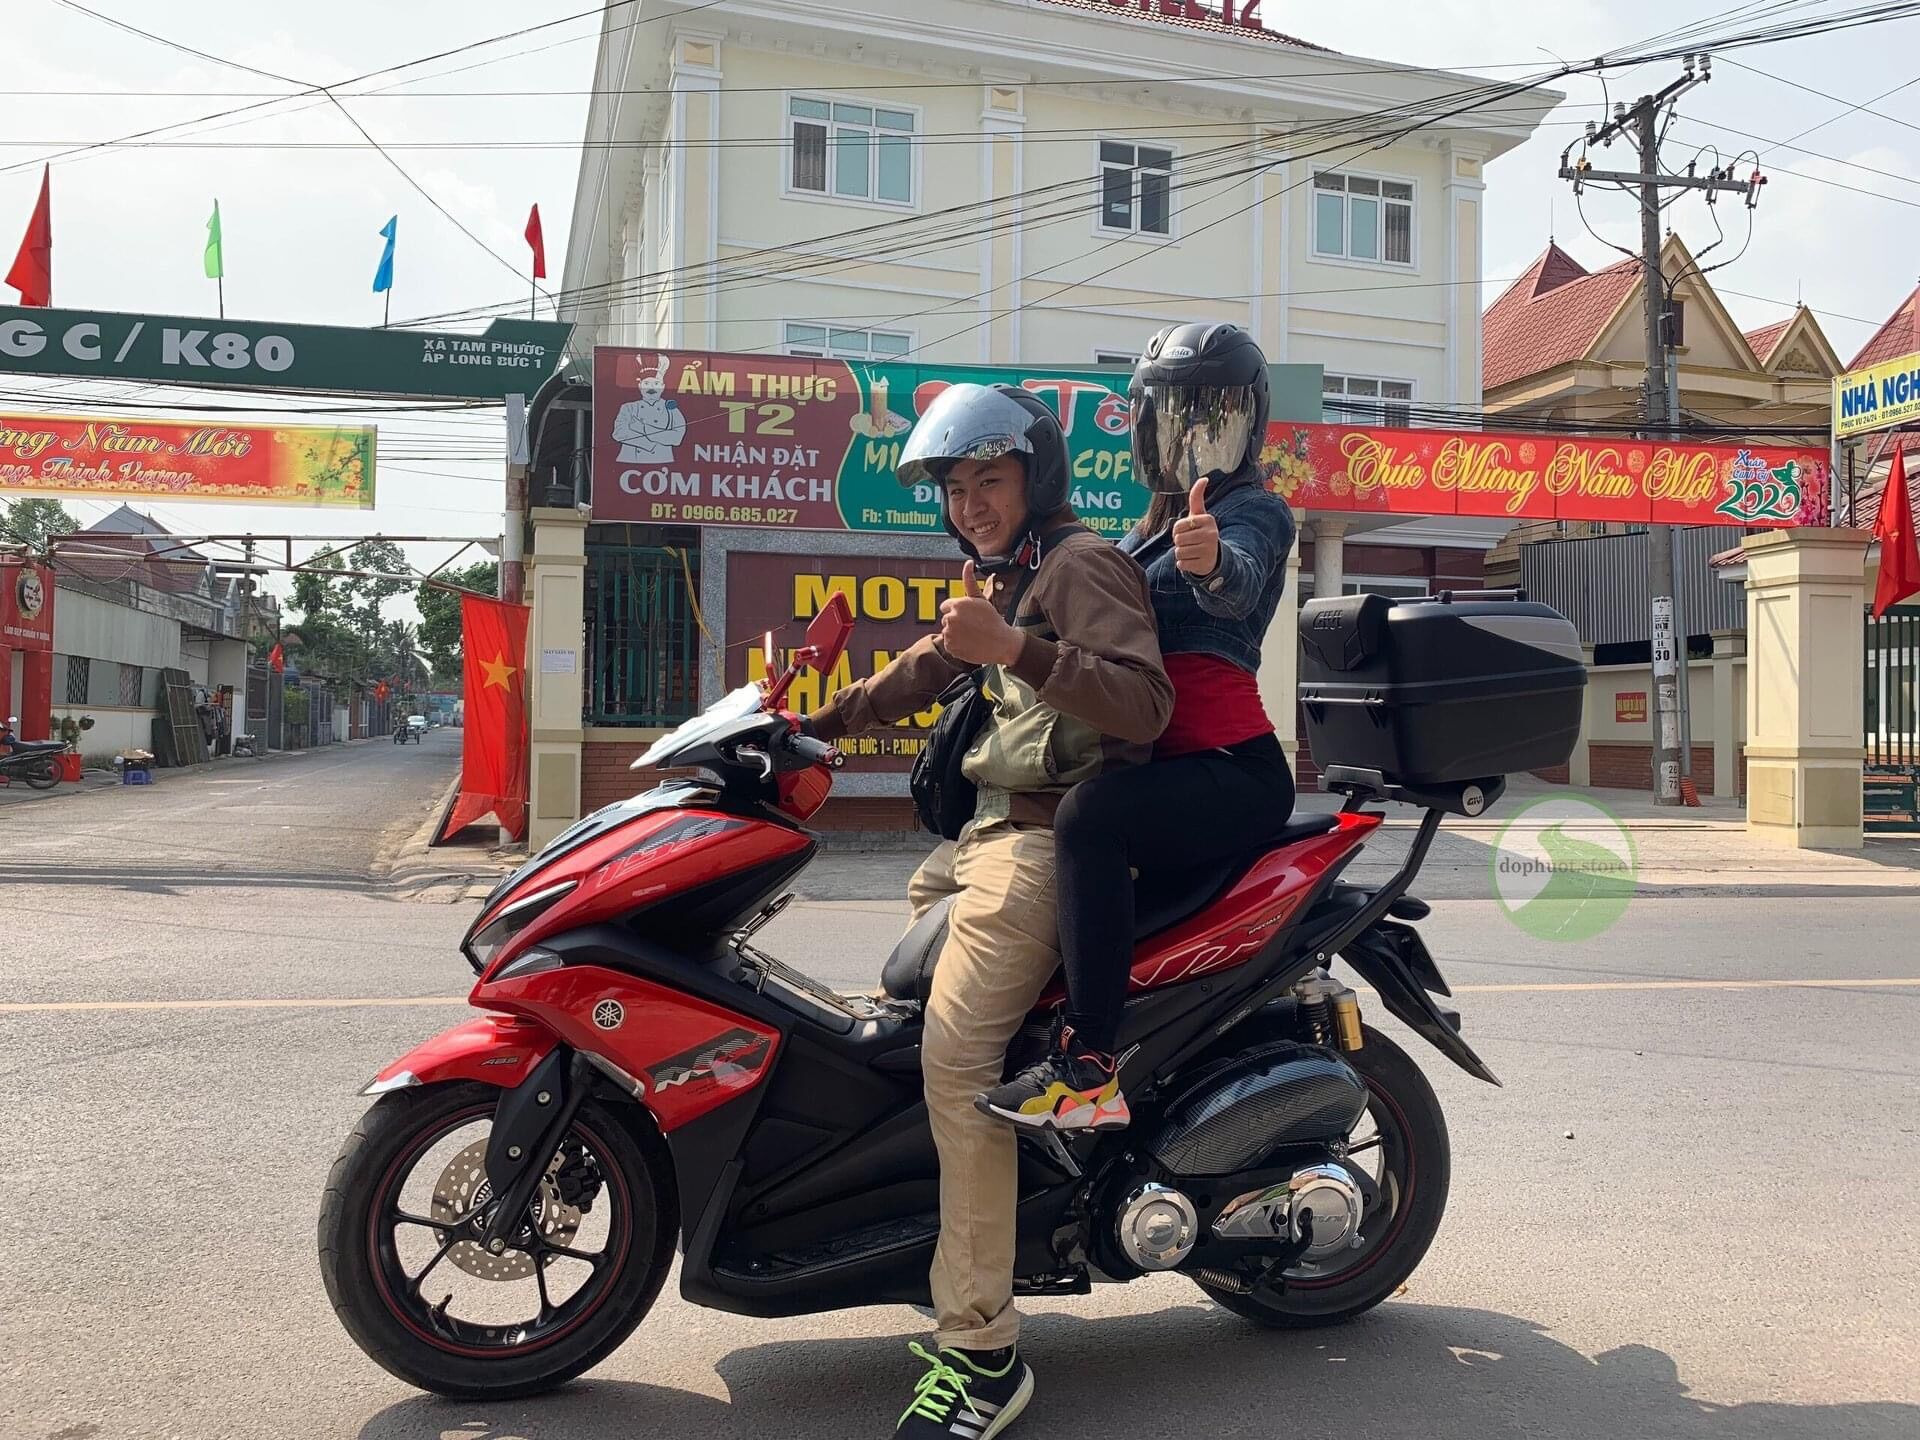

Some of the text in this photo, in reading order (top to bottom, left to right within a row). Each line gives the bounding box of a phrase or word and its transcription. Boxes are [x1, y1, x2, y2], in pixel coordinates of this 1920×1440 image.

[162, 328, 295, 372] K80
[424, 337, 545, 356] XÃ TAM PHƯỚC
[449, 354, 492, 366] LONG
[534, 359, 541, 369] 1
[677, 361, 837, 406] ẨM THỰC
[1841, 374, 1878, 419] NHÀ
[719, 401, 795, 436] T2
[61, 423, 166, 453] Năm
[167, 427, 252, 458] Mới
[694, 441, 820, 471] NHẬN ĐẶT
[1073, 449, 1136, 483] COF
[1340, 432, 1719, 515] Chúc Mừng Năm Mới
[1734, 449, 1767, 468] Xuân
[619, 467, 832, 502] CƠM KHÁCH
[1714, 479, 1802, 522] 2020
[651, 503, 798, 524] ĐT: 0966.685.027
[862, 509, 882, 525] Fb:
[886, 510, 936, 527] Thuthuy
[1655, 649, 1670, 661] 30
[860, 735, 878, 755] ĐỨC
[880, 739, 886, 755] 1
[893, 739, 918, 755] P.TAM
[481, 1056, 519, 1067] ABS
